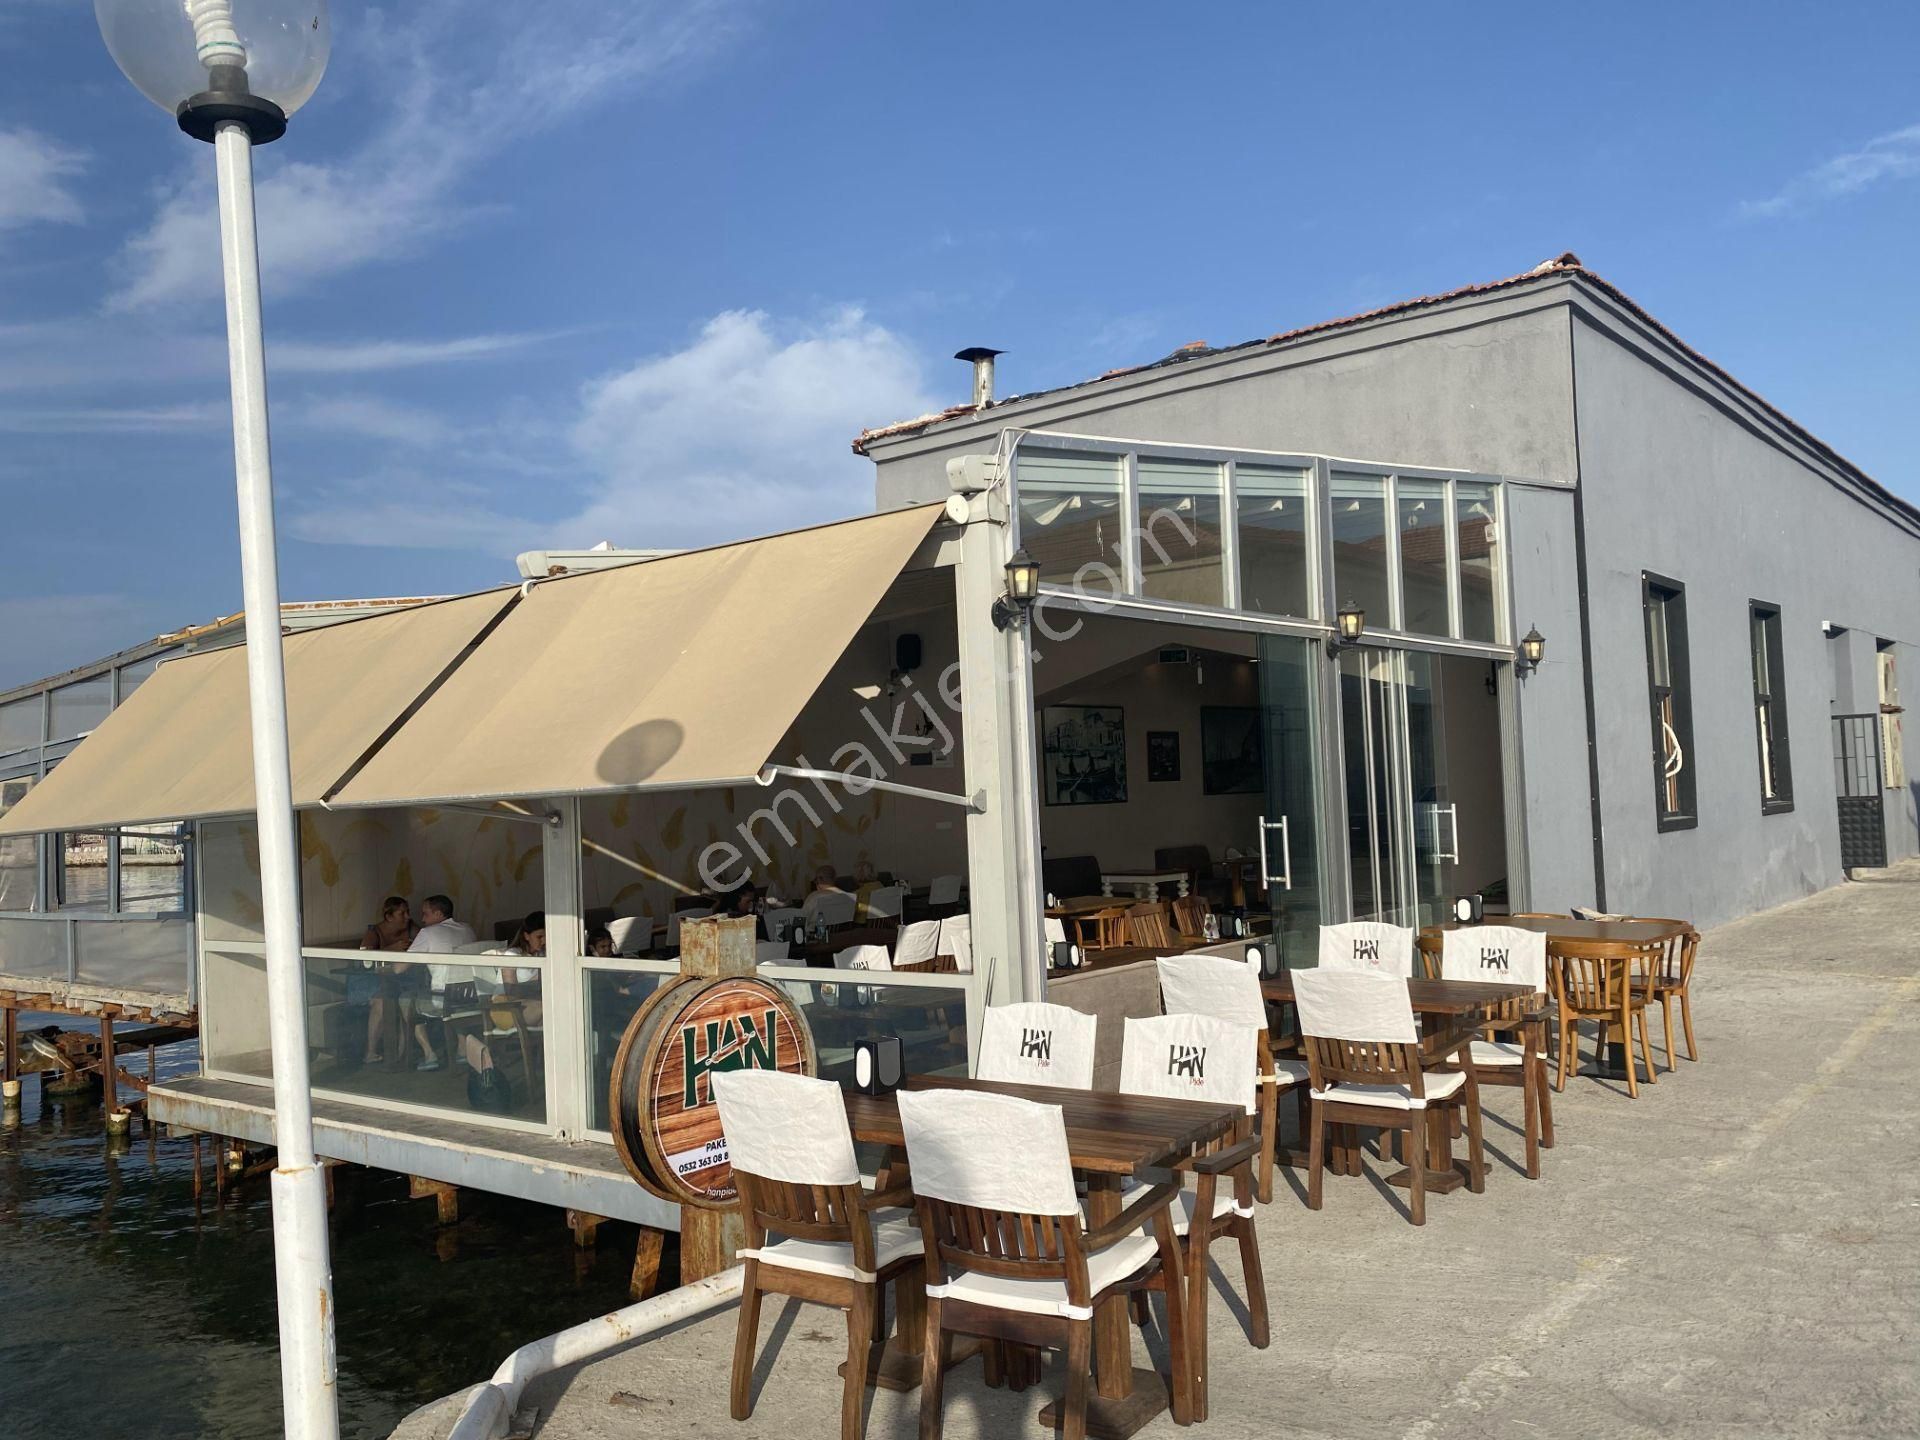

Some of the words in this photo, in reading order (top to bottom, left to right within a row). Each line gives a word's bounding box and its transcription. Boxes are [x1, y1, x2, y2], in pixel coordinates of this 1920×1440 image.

[1353, 939, 1379, 960] HAN
[1480, 947, 1509, 969] HAN
[1019, 1028, 1052, 1060] HAN
[1168, 1044, 1207, 1078] HAN
[706, 1138, 727, 1153] PAKE
[678, 1160, 697, 1173] 0532
[698, 1156, 712, 1168] 363
[713, 1153, 723, 1163] 08
[724, 1151, 729, 1160] 8
